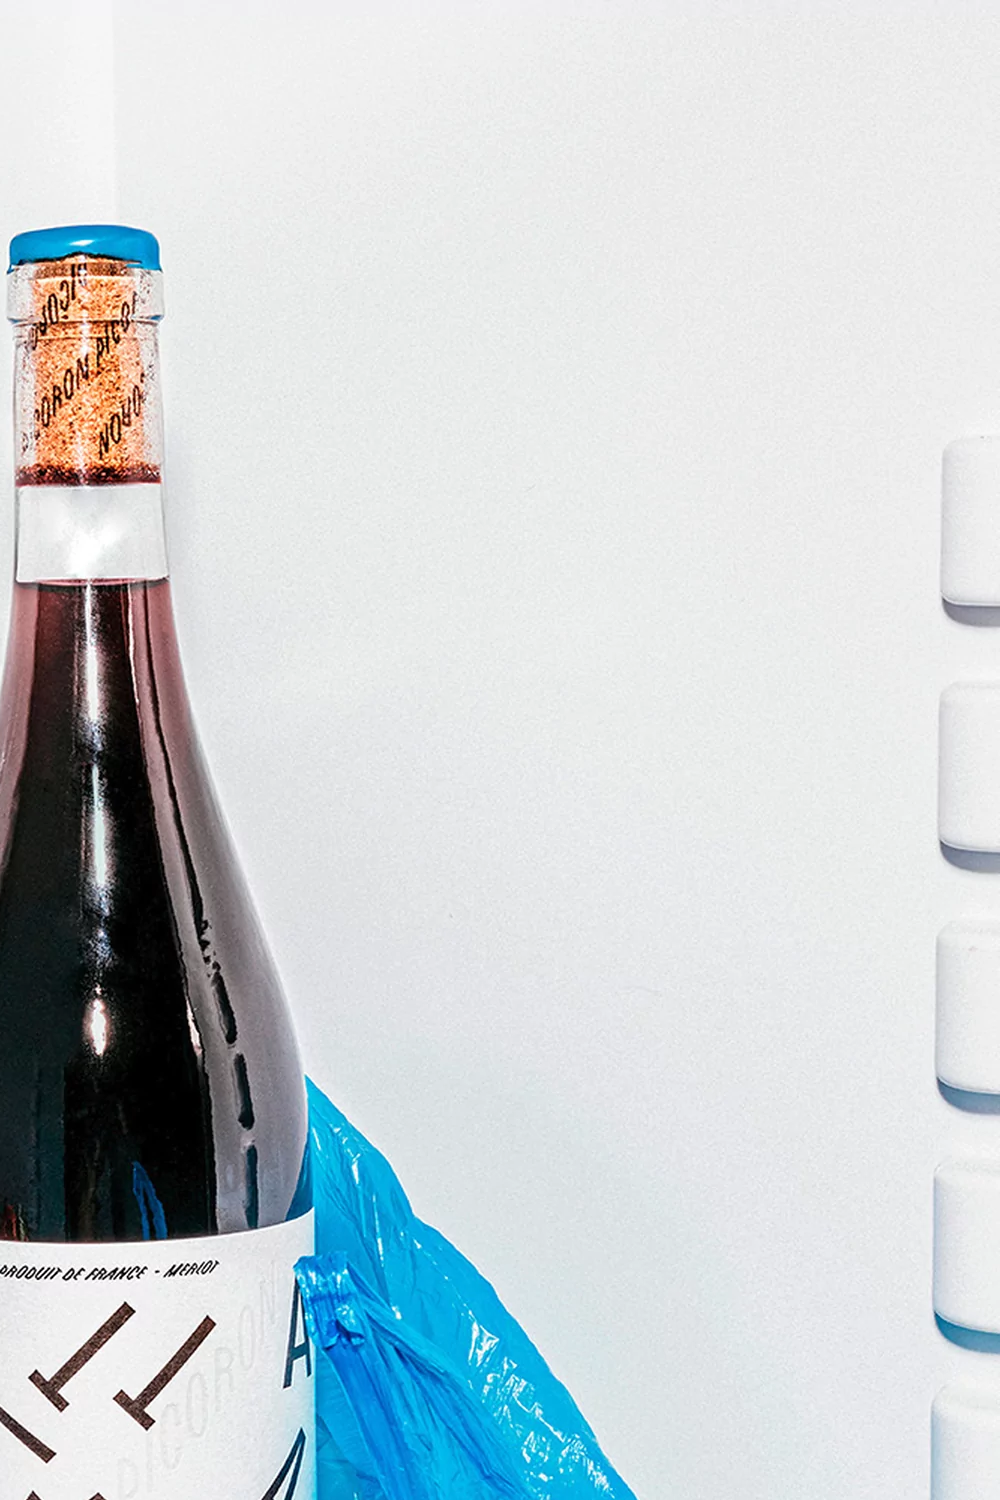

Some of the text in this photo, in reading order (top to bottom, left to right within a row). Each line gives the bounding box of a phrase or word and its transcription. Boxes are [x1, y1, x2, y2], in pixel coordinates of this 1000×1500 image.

[62, 1266, 85, 1282] DE
[84, 1265, 148, 1281] FRANCE
[164, 1260, 220, 1279] MERLOT
